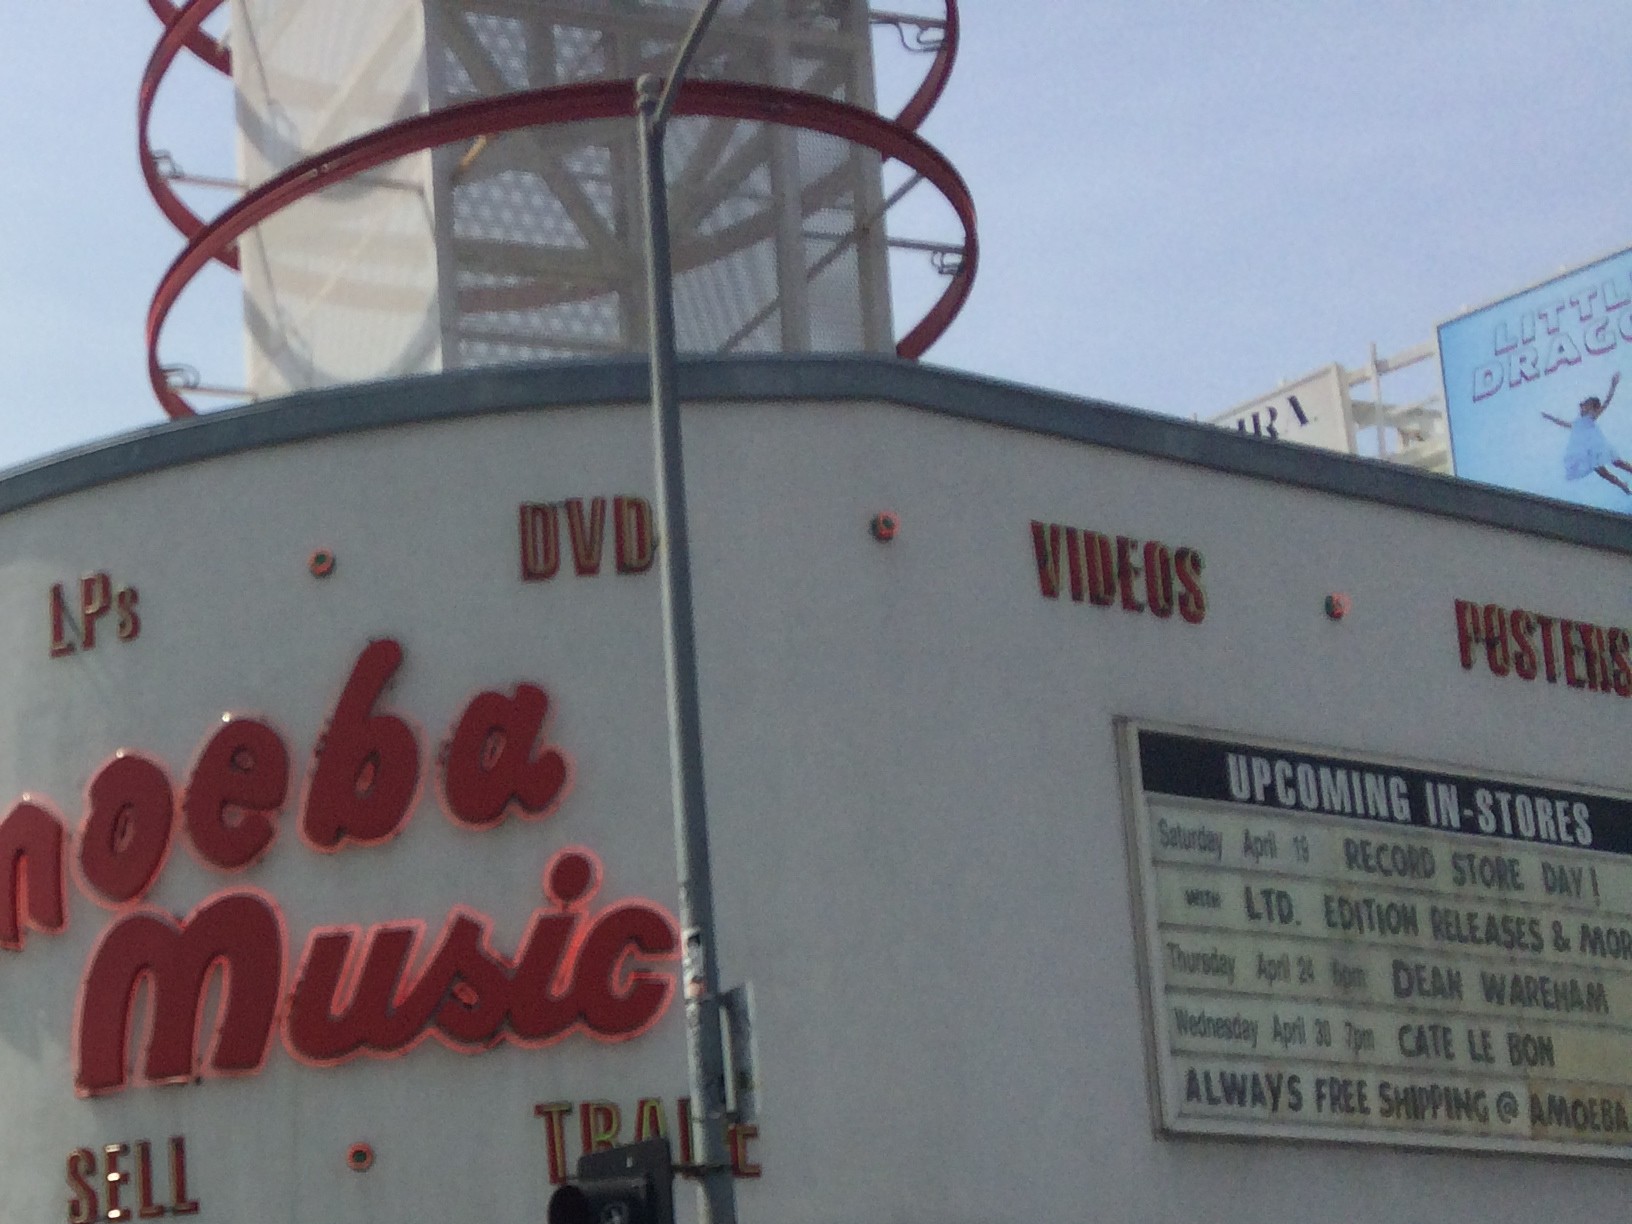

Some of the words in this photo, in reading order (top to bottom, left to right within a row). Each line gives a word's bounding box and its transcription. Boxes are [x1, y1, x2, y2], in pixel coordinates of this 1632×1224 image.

[1494, 272, 1632, 356] LITTL
[46, 569, 141, 658] LPs
[1030, 519, 1206, 625] VIDEOS
[1455, 598, 1632, 697] POSTERS
[1227, 751, 1411, 822] UPCOMING
[1425, 781, 1593, 846] IN-STORES
[1158, 817, 1223, 862] Saturday
[1243, 828, 1277, 863] April
[1343, 837, 1435, 880] RECORD
[1451, 851, 1524, 891] STORE
[1243, 886, 1301, 926] LTD.
[1323, 894, 1419, 936] EDITION
[1431, 905, 1544, 954] RELEASES
[1552, 920, 1571, 952] &
[73, 848, 684, 1097] Music
[1166, 942, 1236, 985] Thursday
[1256, 951, 1290, 987] April
[1392, 958, 1463, 1000] DEAN
[1480, 970, 1609, 1014] WAREHAM
[1174, 1007, 1258, 1048] Wednesday
[1273, 1013, 1306, 1049] April
[1398, 1023, 1456, 1061] CATE
[1468, 1028, 1496, 1064] LE
[1506, 1032, 1556, 1067] BON
[1185, 1066, 1303, 1113] ALWAYS
[1314, 1075, 1371, 1115] FREE
[1378, 1081, 1490, 1124] SHIPPING
[1496, 1090, 1518, 1124] @
[1529, 1093, 1630, 1133] AMOEBA
